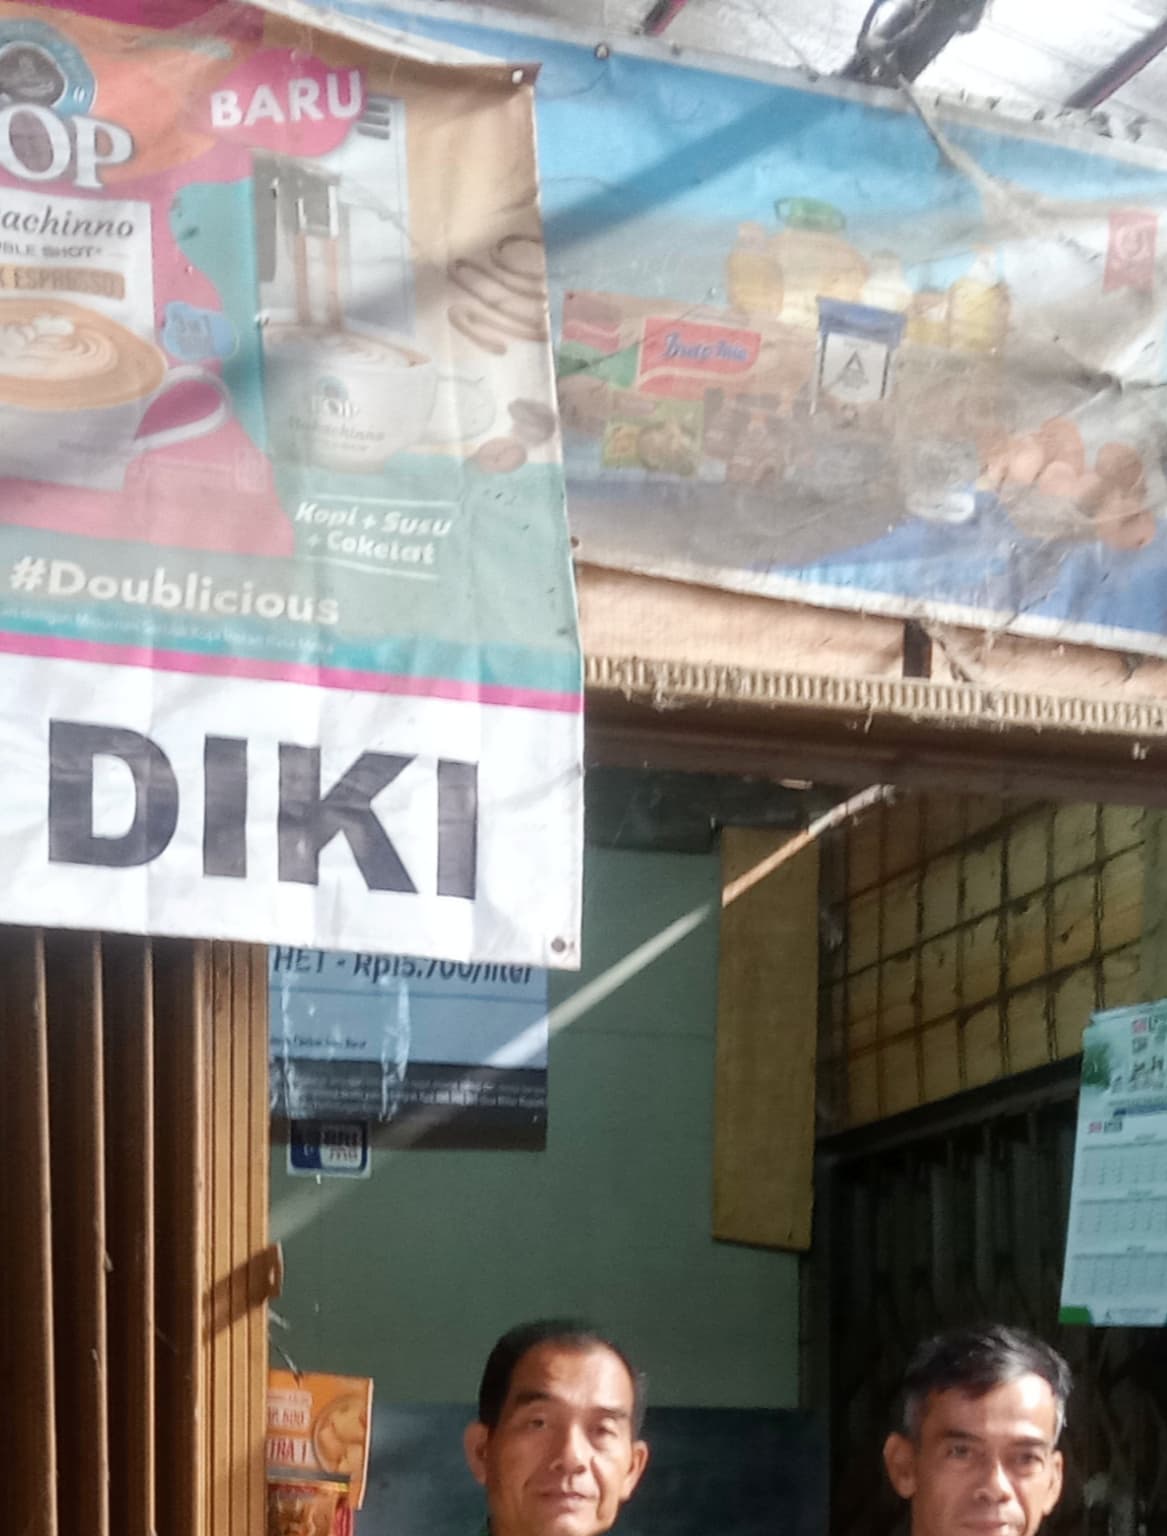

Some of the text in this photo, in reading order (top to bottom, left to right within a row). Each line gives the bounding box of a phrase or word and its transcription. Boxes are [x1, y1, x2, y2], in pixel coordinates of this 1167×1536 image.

[209, 70, 364, 128] BARU
[296, 500, 359, 527] Kopi
[380, 511, 453, 537] Susu
[326, 529, 435, 565] Cokelat
[10, 555, 341, 625] #Doublicious
[48, 718, 479, 901] DIKI
